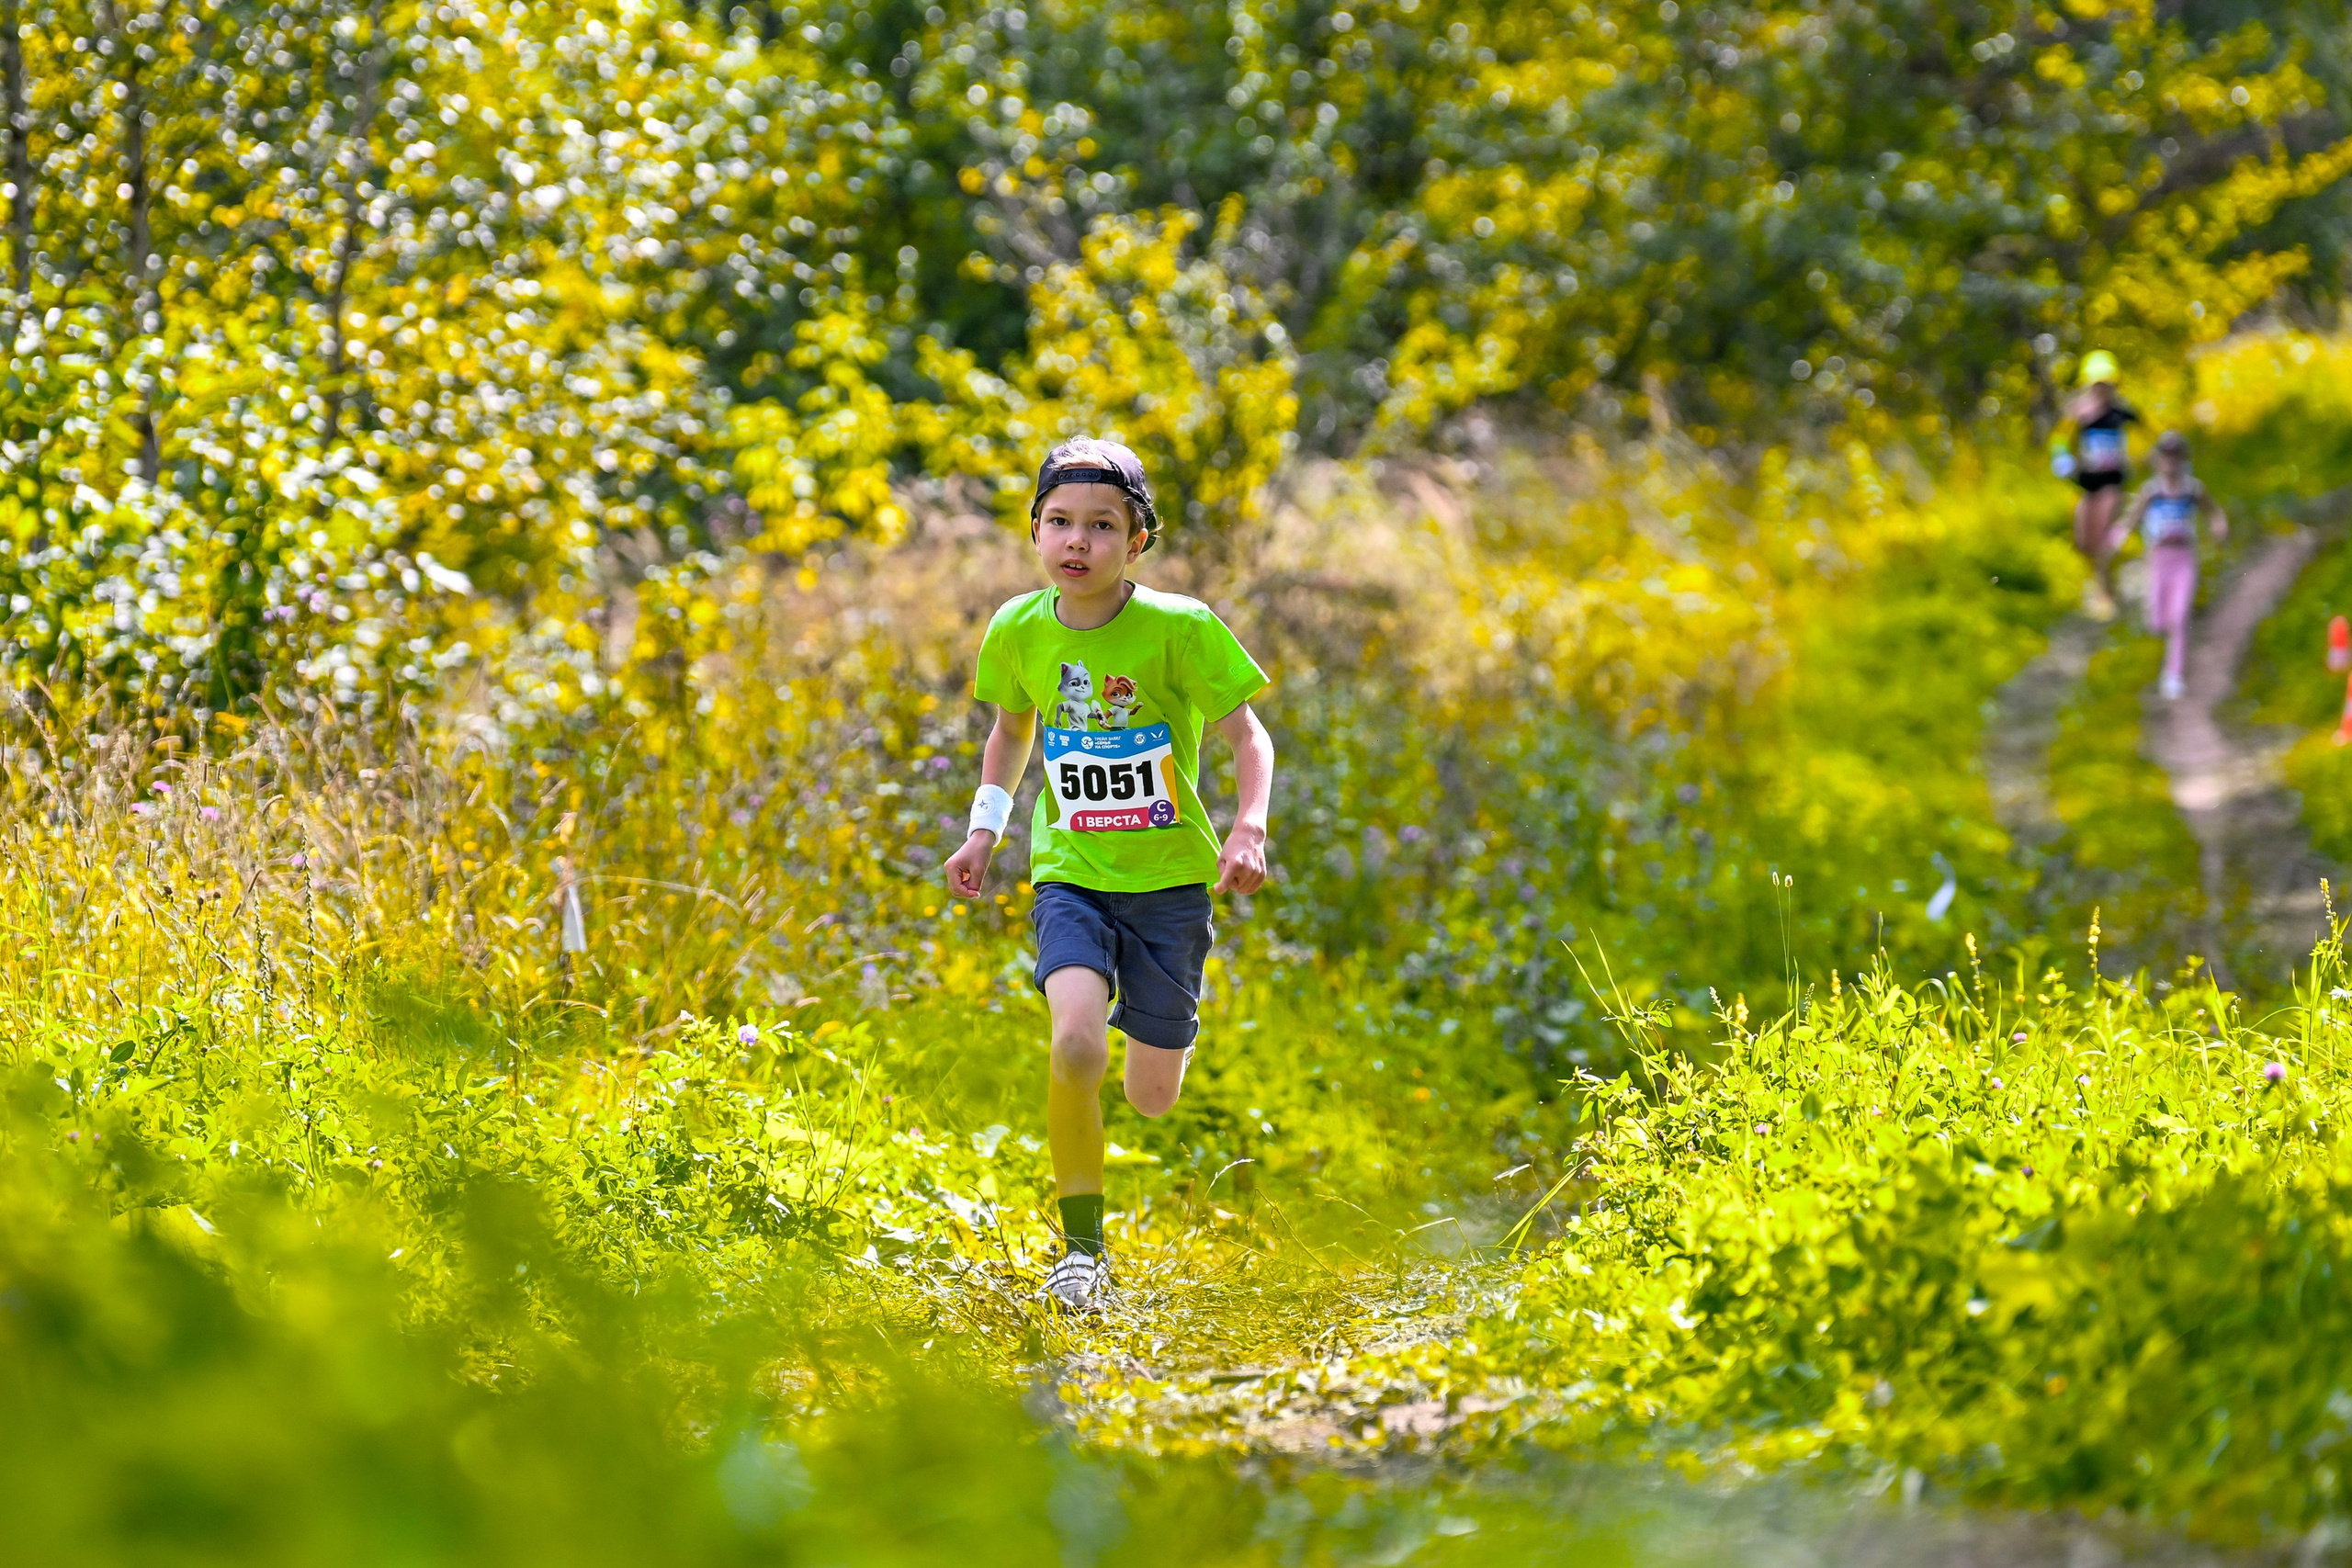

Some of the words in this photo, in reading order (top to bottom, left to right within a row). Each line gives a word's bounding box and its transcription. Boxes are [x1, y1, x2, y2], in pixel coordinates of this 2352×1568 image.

[1059, 760, 1155, 801] 5051
[1077, 816, 1083, 827] 1
[1086, 815, 1141, 828] ВЕРСТА
